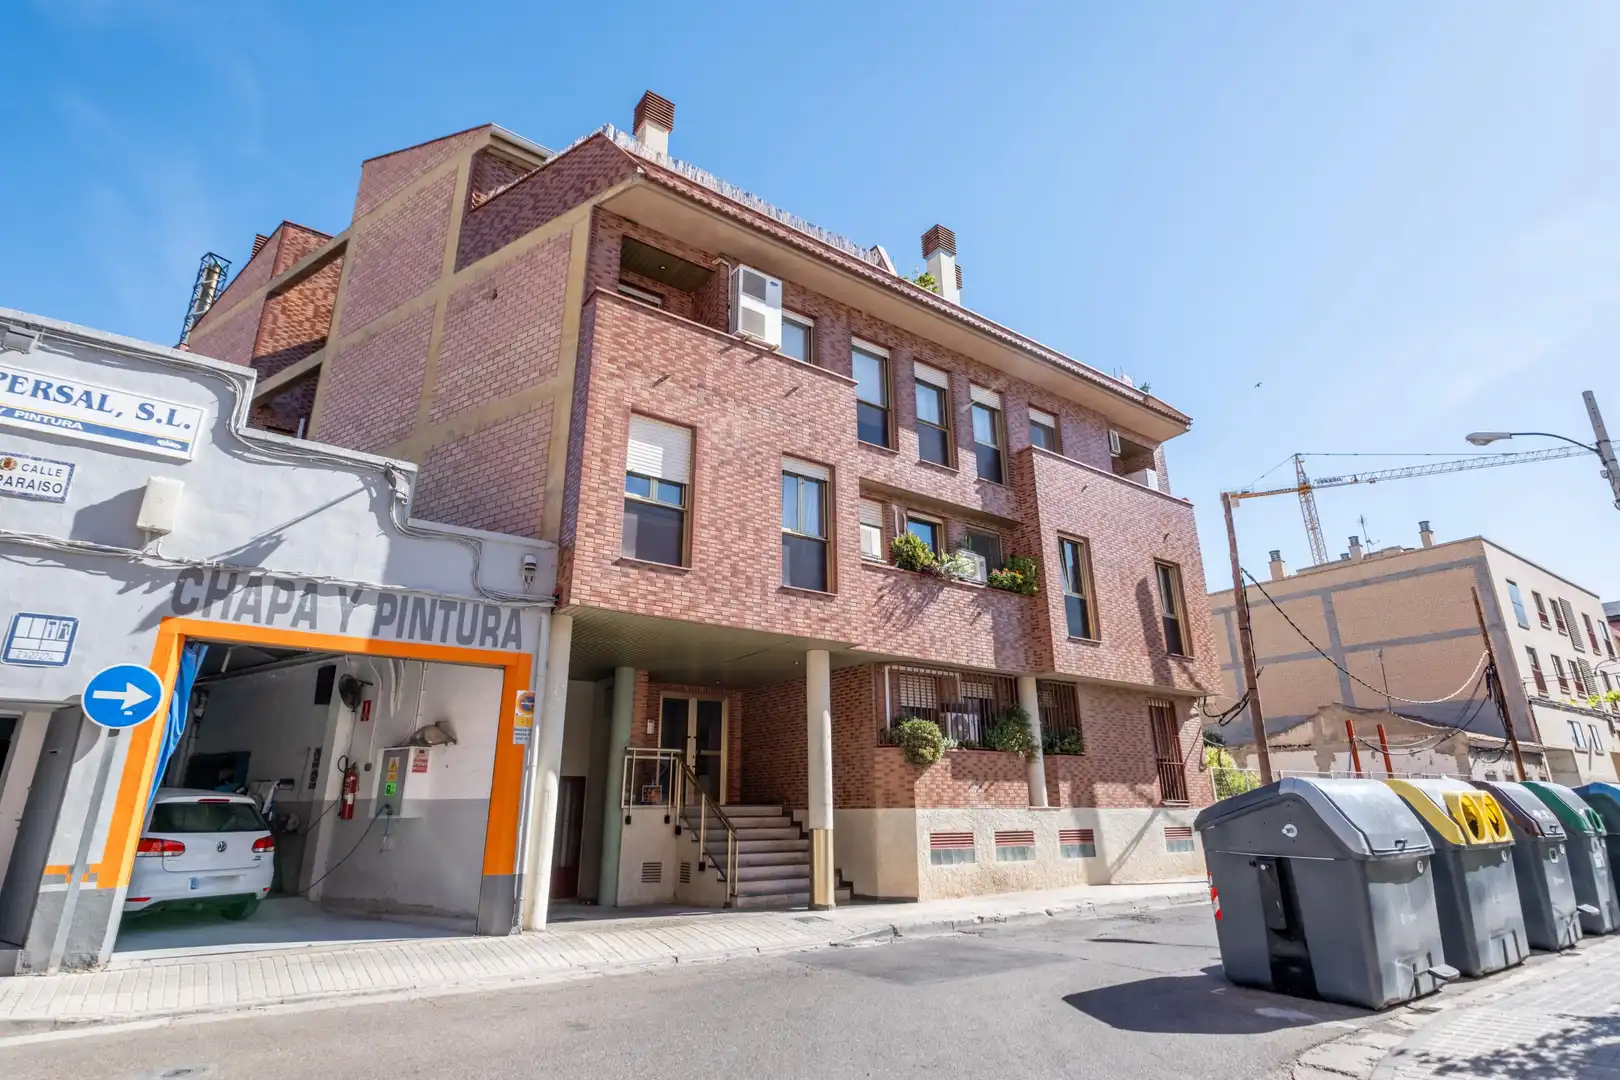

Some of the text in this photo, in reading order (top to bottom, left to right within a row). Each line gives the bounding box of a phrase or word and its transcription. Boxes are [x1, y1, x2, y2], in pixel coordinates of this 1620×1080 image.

[14, 409, 83, 430] PINTURA
[136, 402, 190, 430] S.L.
[21, 463, 63, 477] CALLE
[171, 567, 522, 650] CHAPA Y PINTURA
